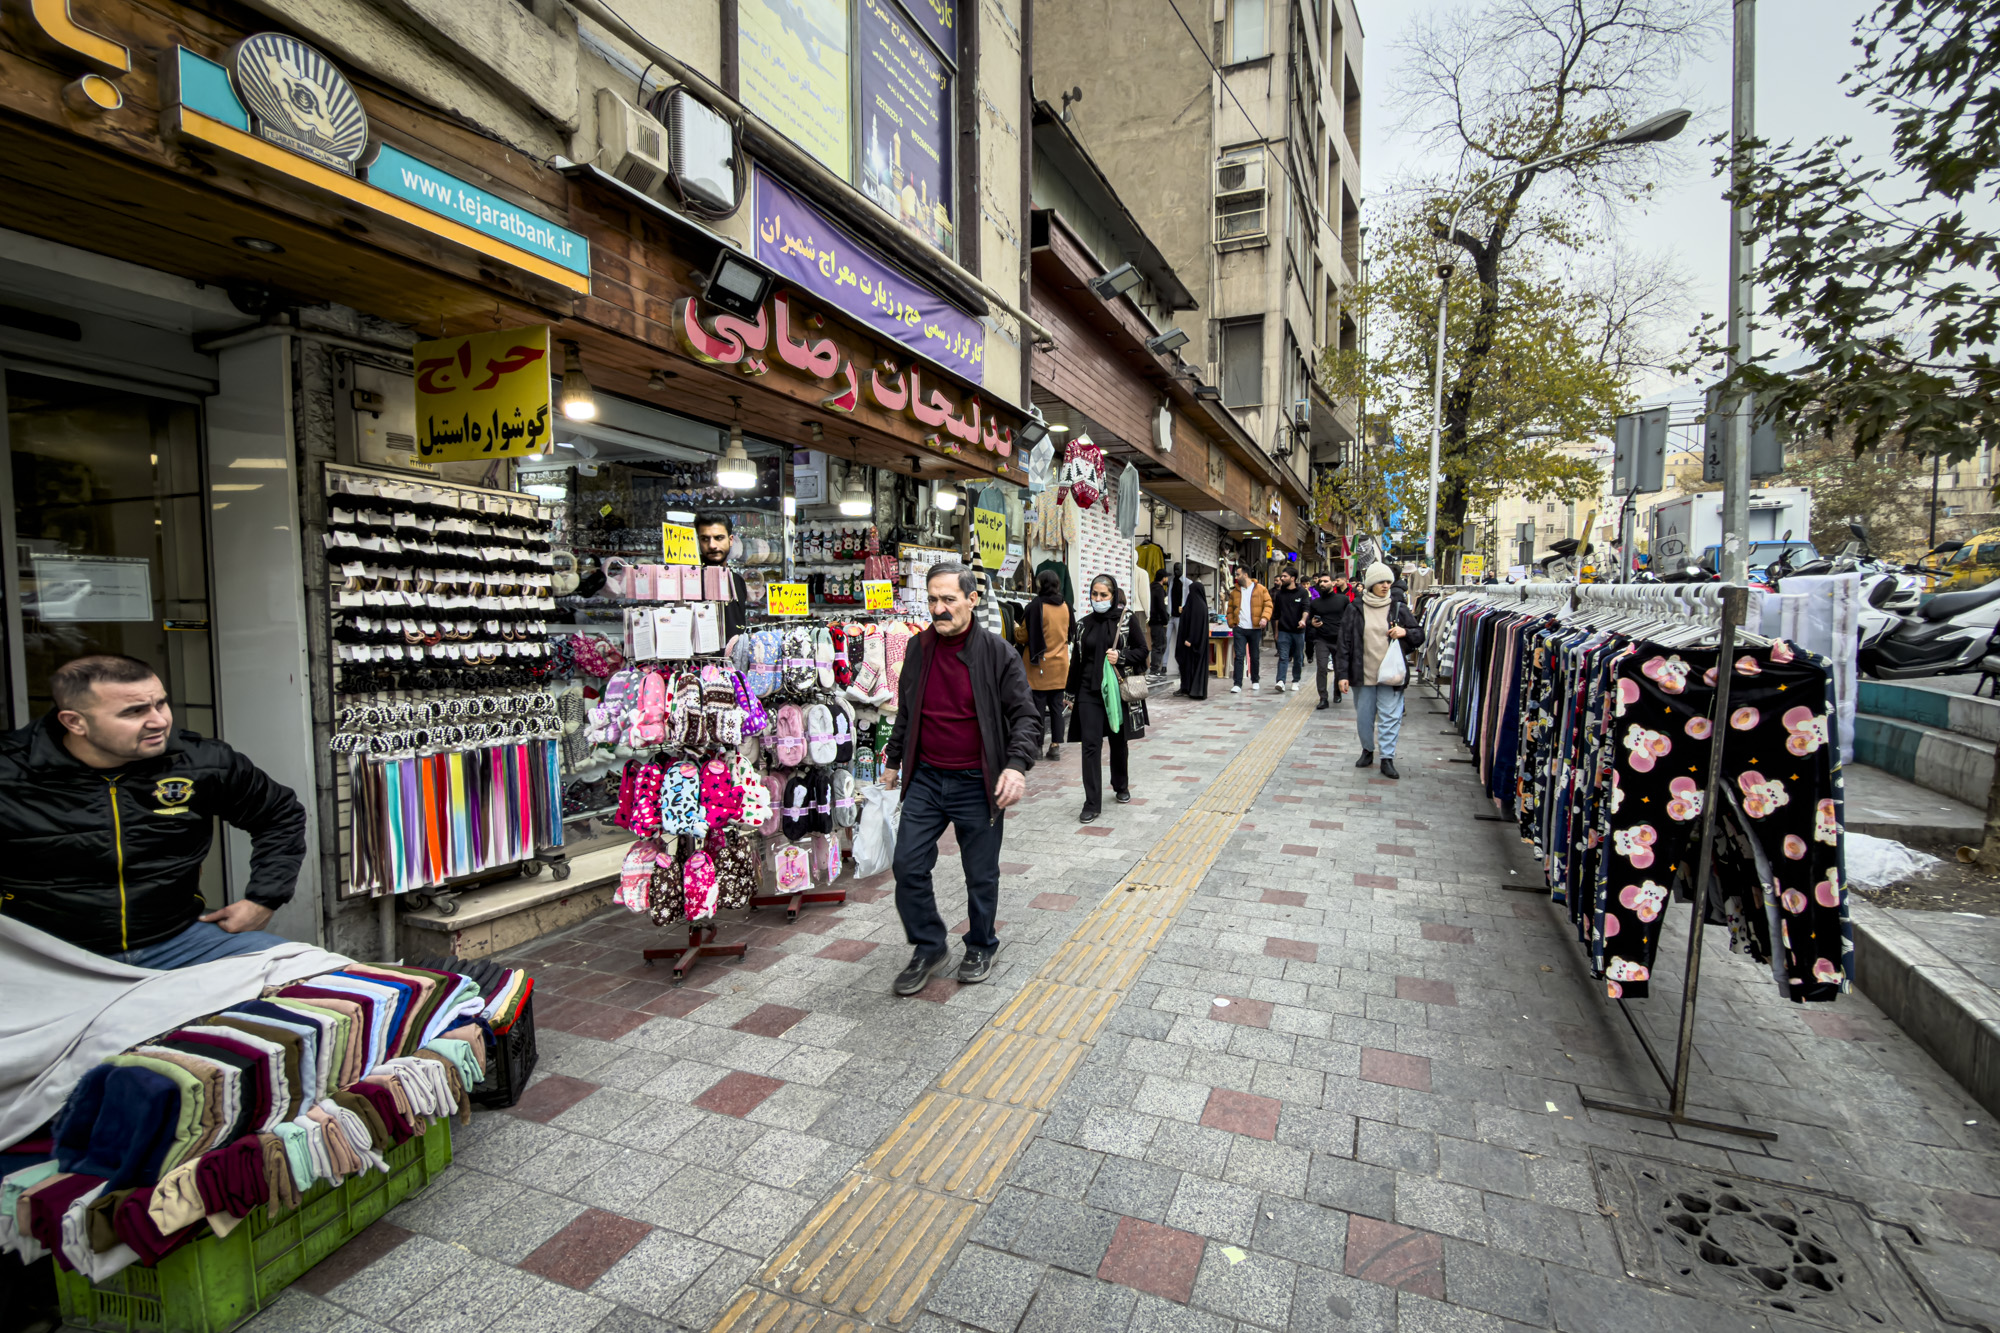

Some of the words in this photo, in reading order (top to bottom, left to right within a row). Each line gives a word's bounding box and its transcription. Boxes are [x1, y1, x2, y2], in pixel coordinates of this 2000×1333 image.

[296, 142, 314, 154] BANK
[401, 167, 573, 258] www.tejaratbank.ir
[760, 214, 815, 261] شمیران
[818, 250, 857, 287] معراج
[859, 275, 894, 316] زیارت
[895, 302, 903, 322] و
[904, 304, 922, 328] حج
[684, 289, 859, 412] رضایی
[924, 322, 951, 349] رسمی
[951, 332, 983, 365] کارگزار
[417, 340, 546, 395] حراج
[420, 411, 470, 456] استیل
[470, 402, 548, 453] گوشواره
[870, 357, 1013, 473] بدلیجات
[976, 512, 989, 529] بافت
[990, 516, 1003, 532] حراج
[167, 783, 184, 798] H
